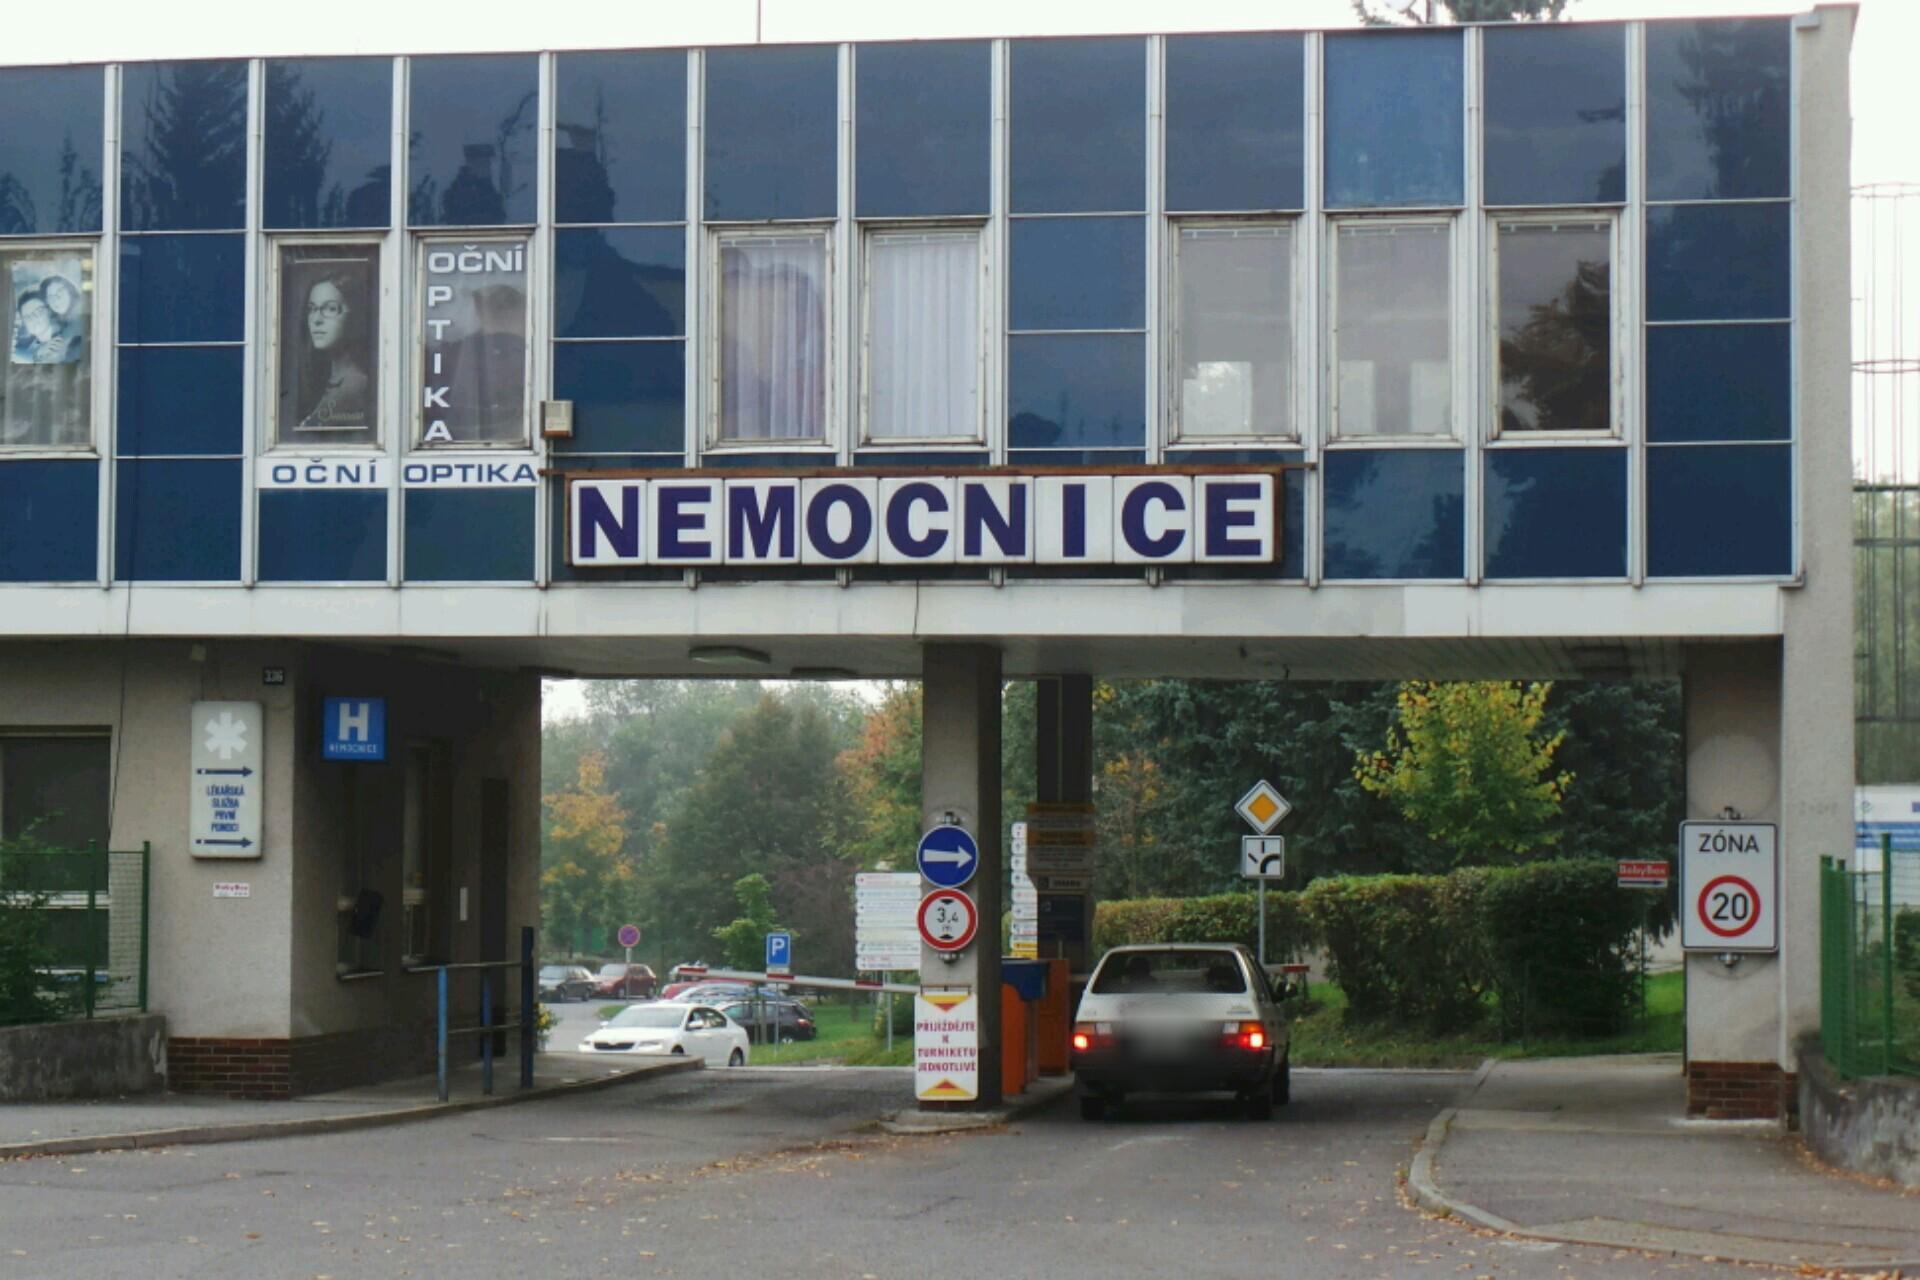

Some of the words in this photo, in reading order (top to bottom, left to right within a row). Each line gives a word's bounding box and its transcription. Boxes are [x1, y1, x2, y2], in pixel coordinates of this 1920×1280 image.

[428, 245, 524, 273] OČNÍ
[271, 457, 377, 484] OČNÍ
[403, 463, 538, 484] OPTIKA
[578, 482, 1263, 560] NEMOCNICE
[339, 702, 369, 742] H
[329, 743, 377, 753] NEMOCNICE
[1698, 829, 1760, 854] ZÓNA
[1712, 892, 1749, 921] 20
[772, 938, 785, 956] P
[917, 1047, 976, 1058] TURNIKETU
